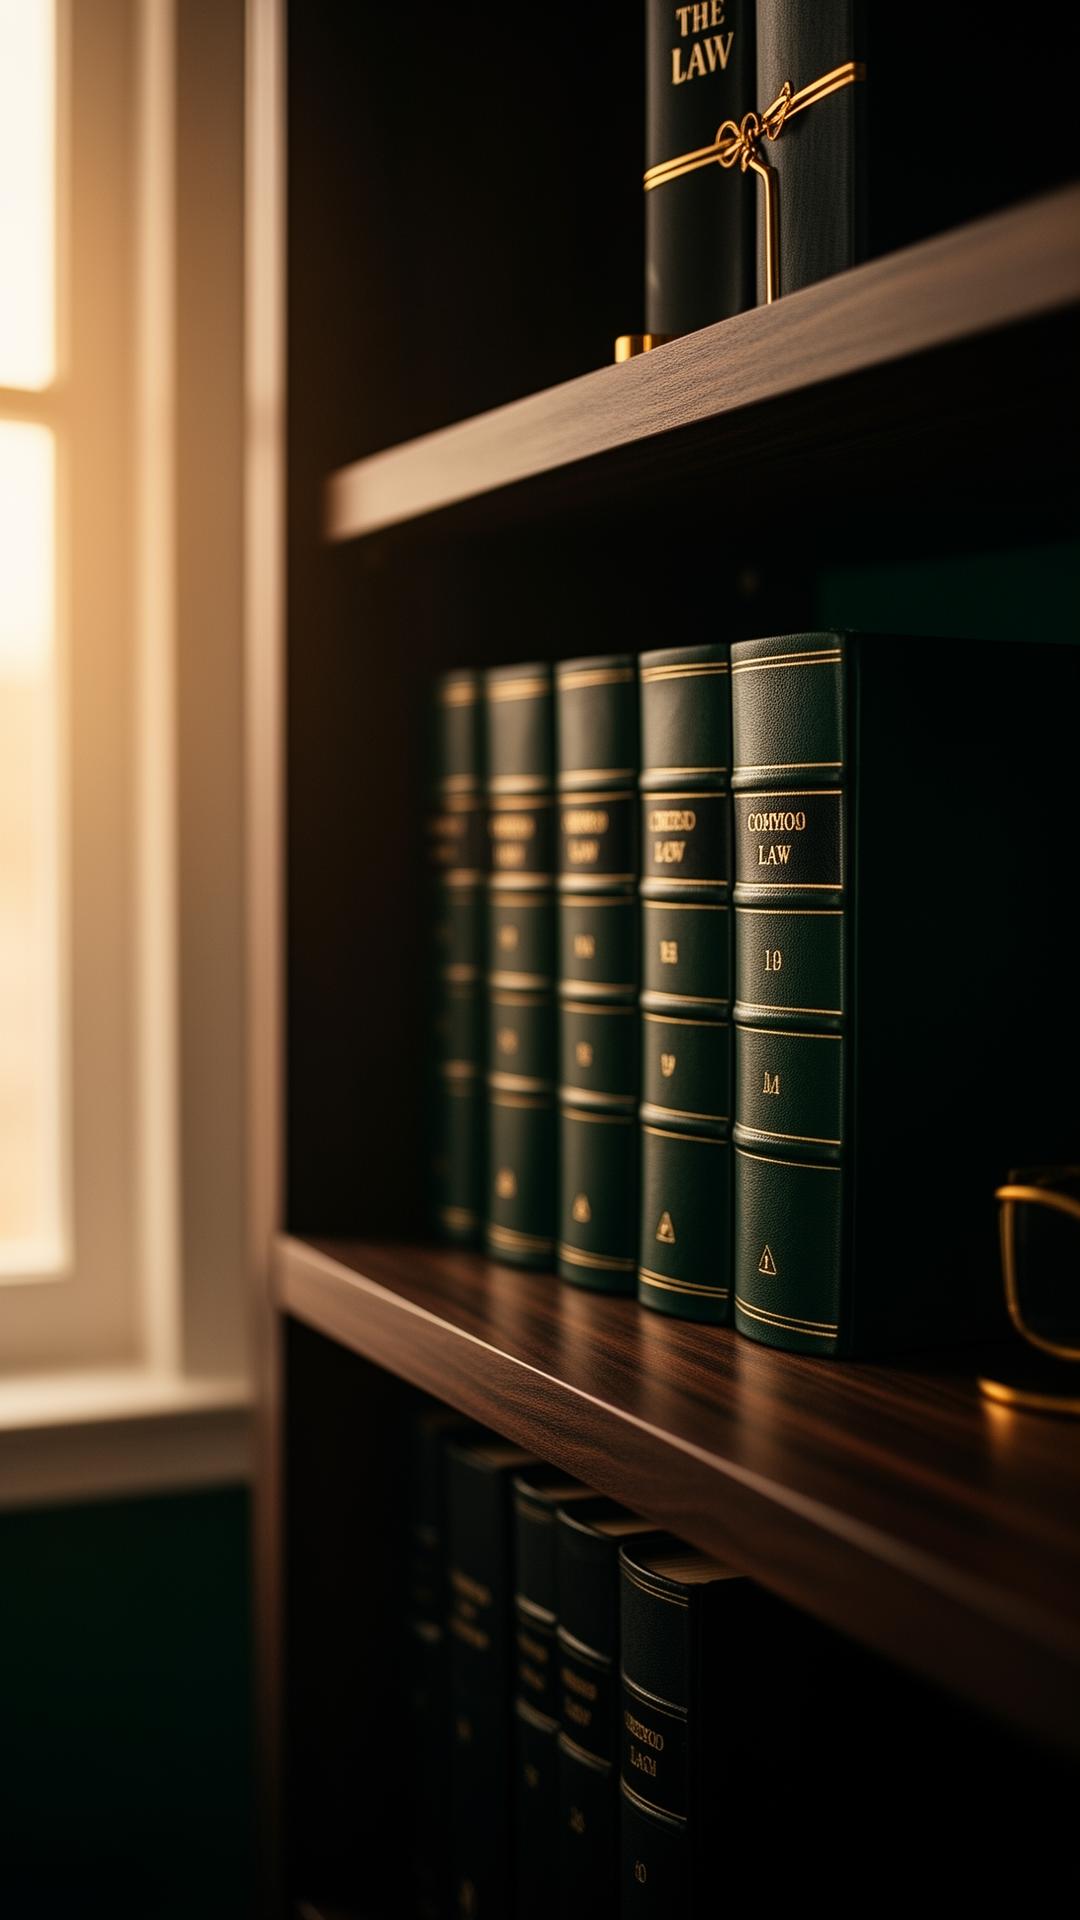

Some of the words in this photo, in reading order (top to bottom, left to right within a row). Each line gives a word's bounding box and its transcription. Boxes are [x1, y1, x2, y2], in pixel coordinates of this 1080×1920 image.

[676, 0, 725, 37] THE
[672, 32, 734, 85] LAW
[758, 845, 792, 865] LAW
